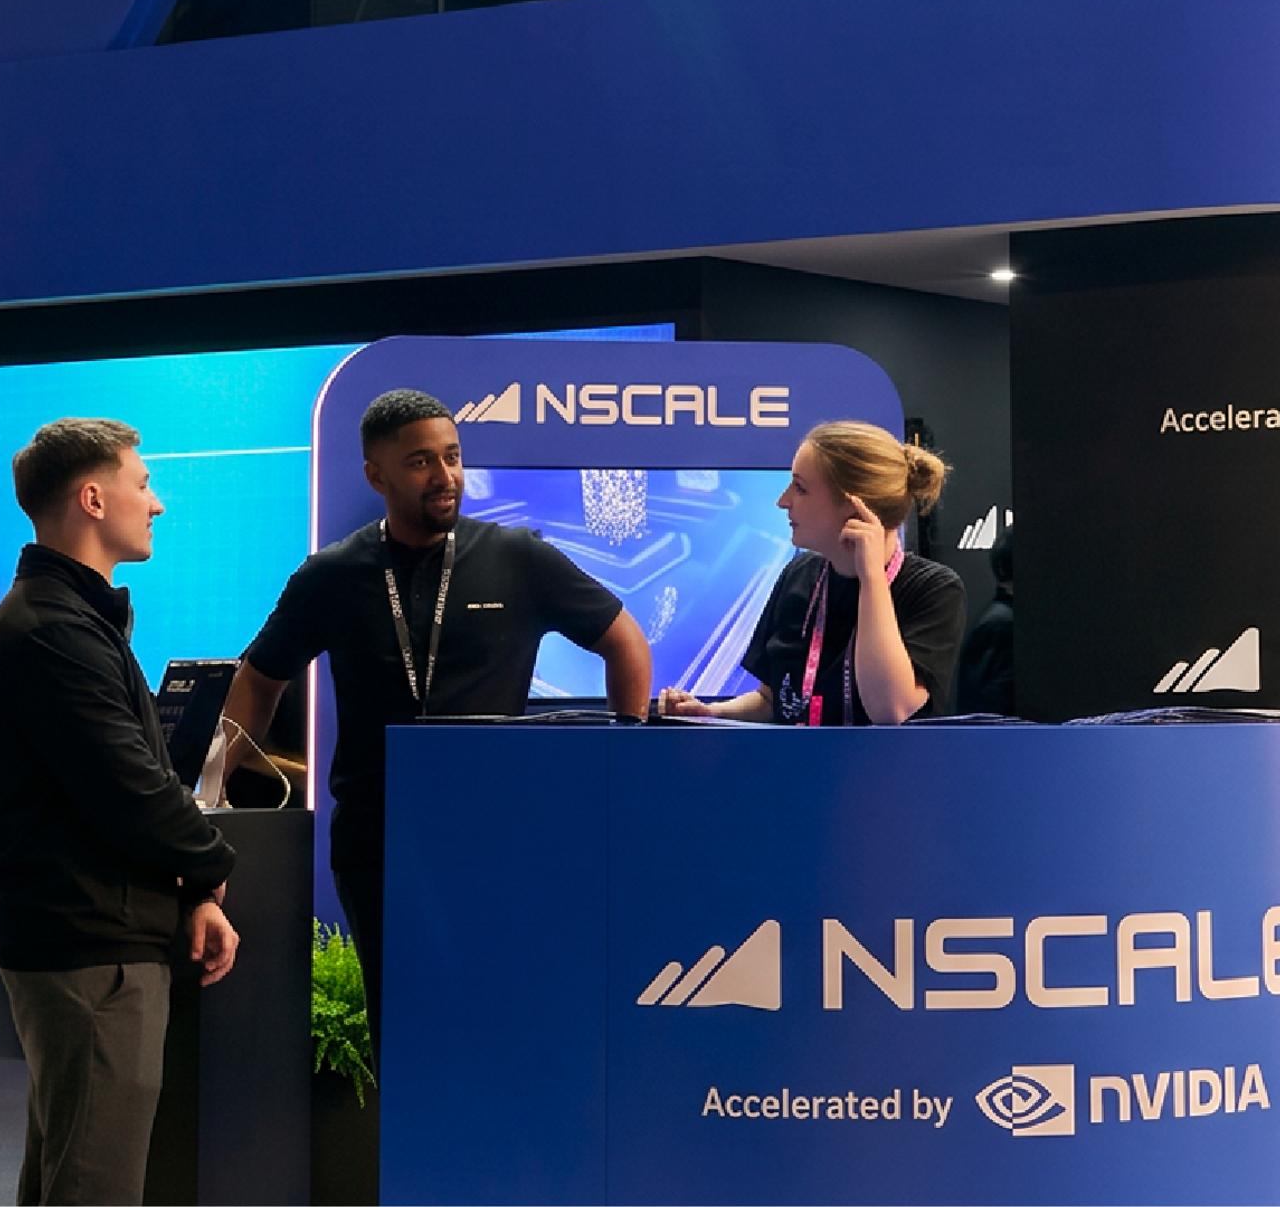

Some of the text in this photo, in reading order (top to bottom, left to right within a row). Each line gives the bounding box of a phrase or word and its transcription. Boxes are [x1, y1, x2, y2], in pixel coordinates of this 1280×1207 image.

[535, 383, 790, 428] NSCALE
[701, 1085, 902, 1122] Accelerated
[911, 1087, 954, 1130] by
